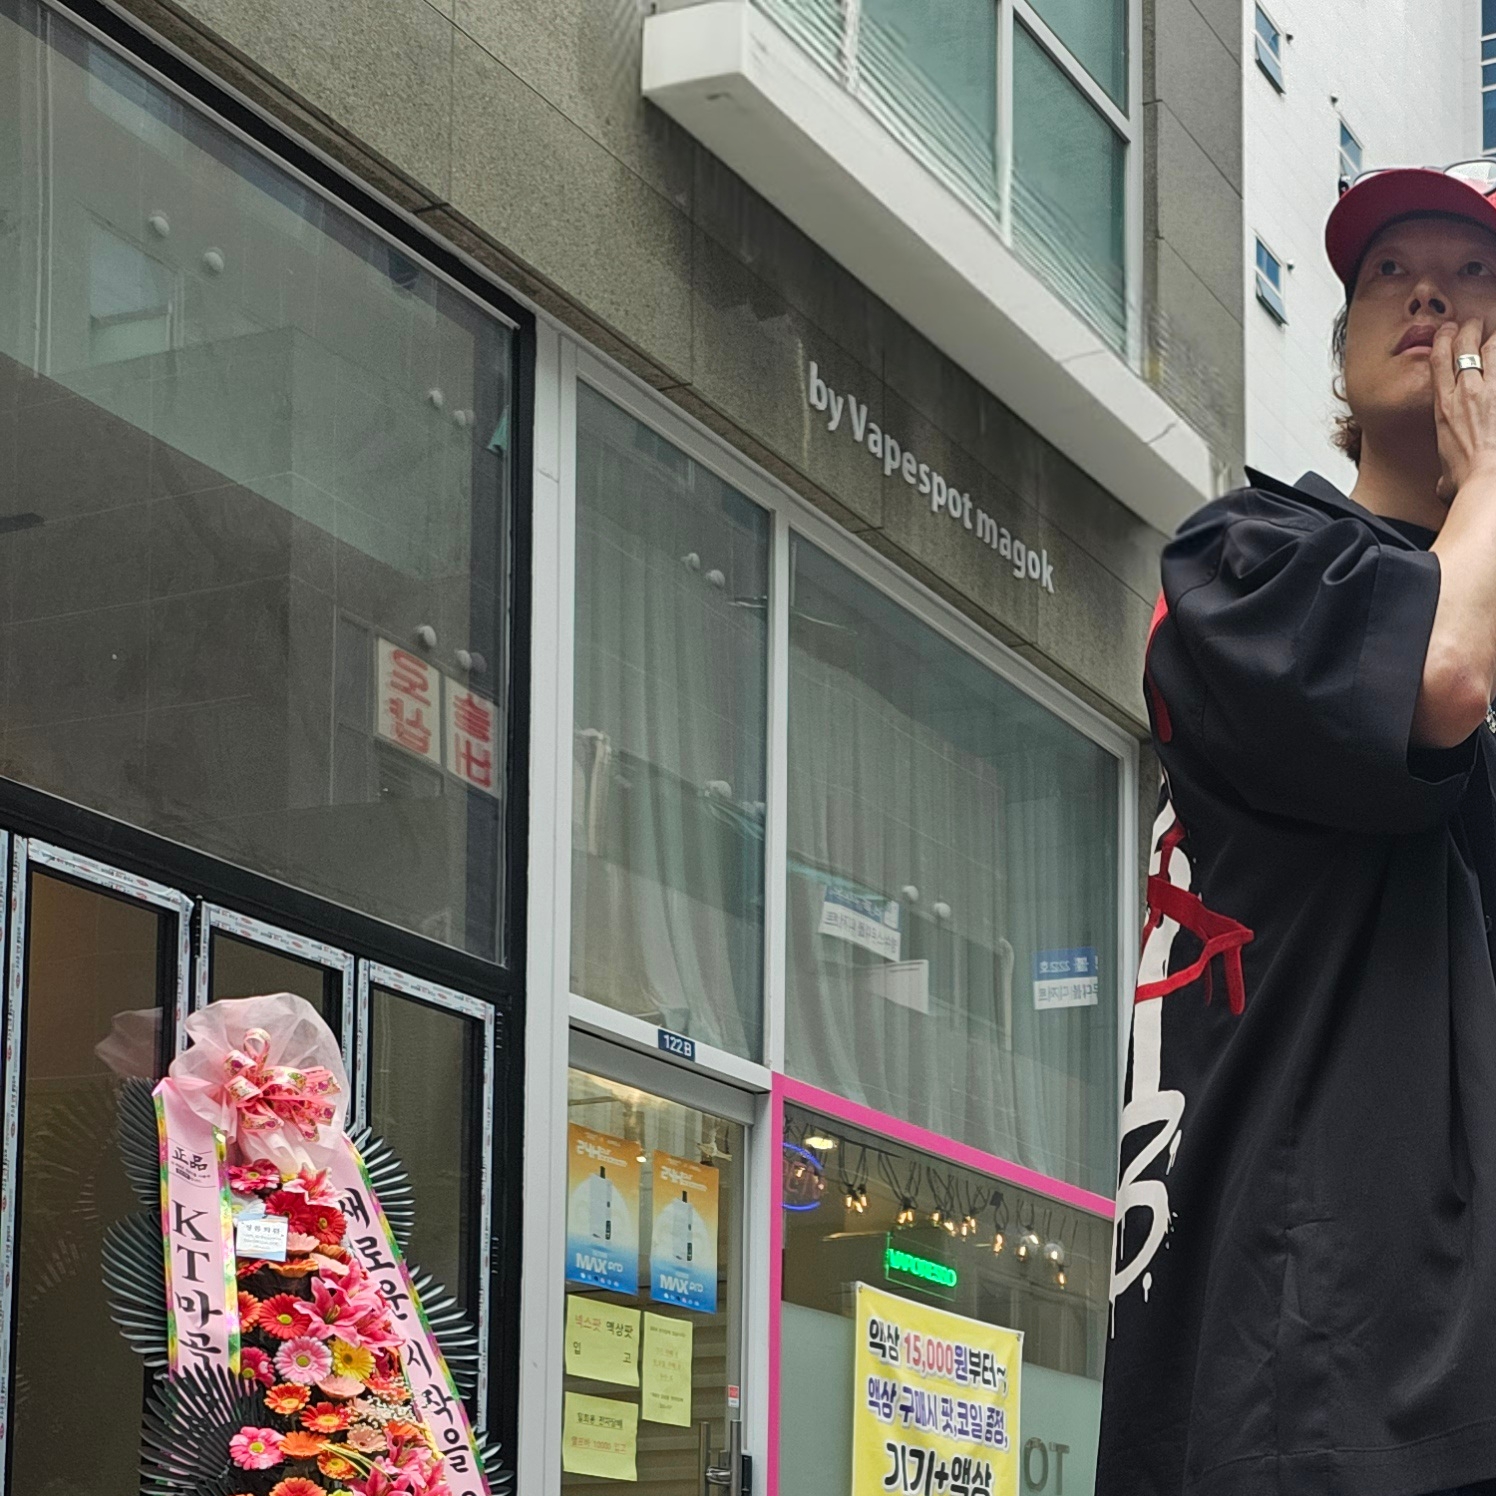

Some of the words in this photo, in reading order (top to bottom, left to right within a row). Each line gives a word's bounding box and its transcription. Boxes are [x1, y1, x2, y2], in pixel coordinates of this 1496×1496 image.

[809, 361, 844, 431] by
[848, 394, 973, 530] Vapespot
[976, 508, 1055, 594] magok
[663, 1034, 692, 1057] 122B
[172, 1146, 208, 1171] 正品
[576, 1252, 608, 1275] MAX
[660, 1274, 689, 1295] MAX
[340, 1187, 412, 1321] 새로운
[407, 1339, 470, 1474] 시작을
[869, 1318, 900, 1362] 액상
[868, 1377, 898, 1419] 액상
[899, 1386, 939, 1431] 구매시
